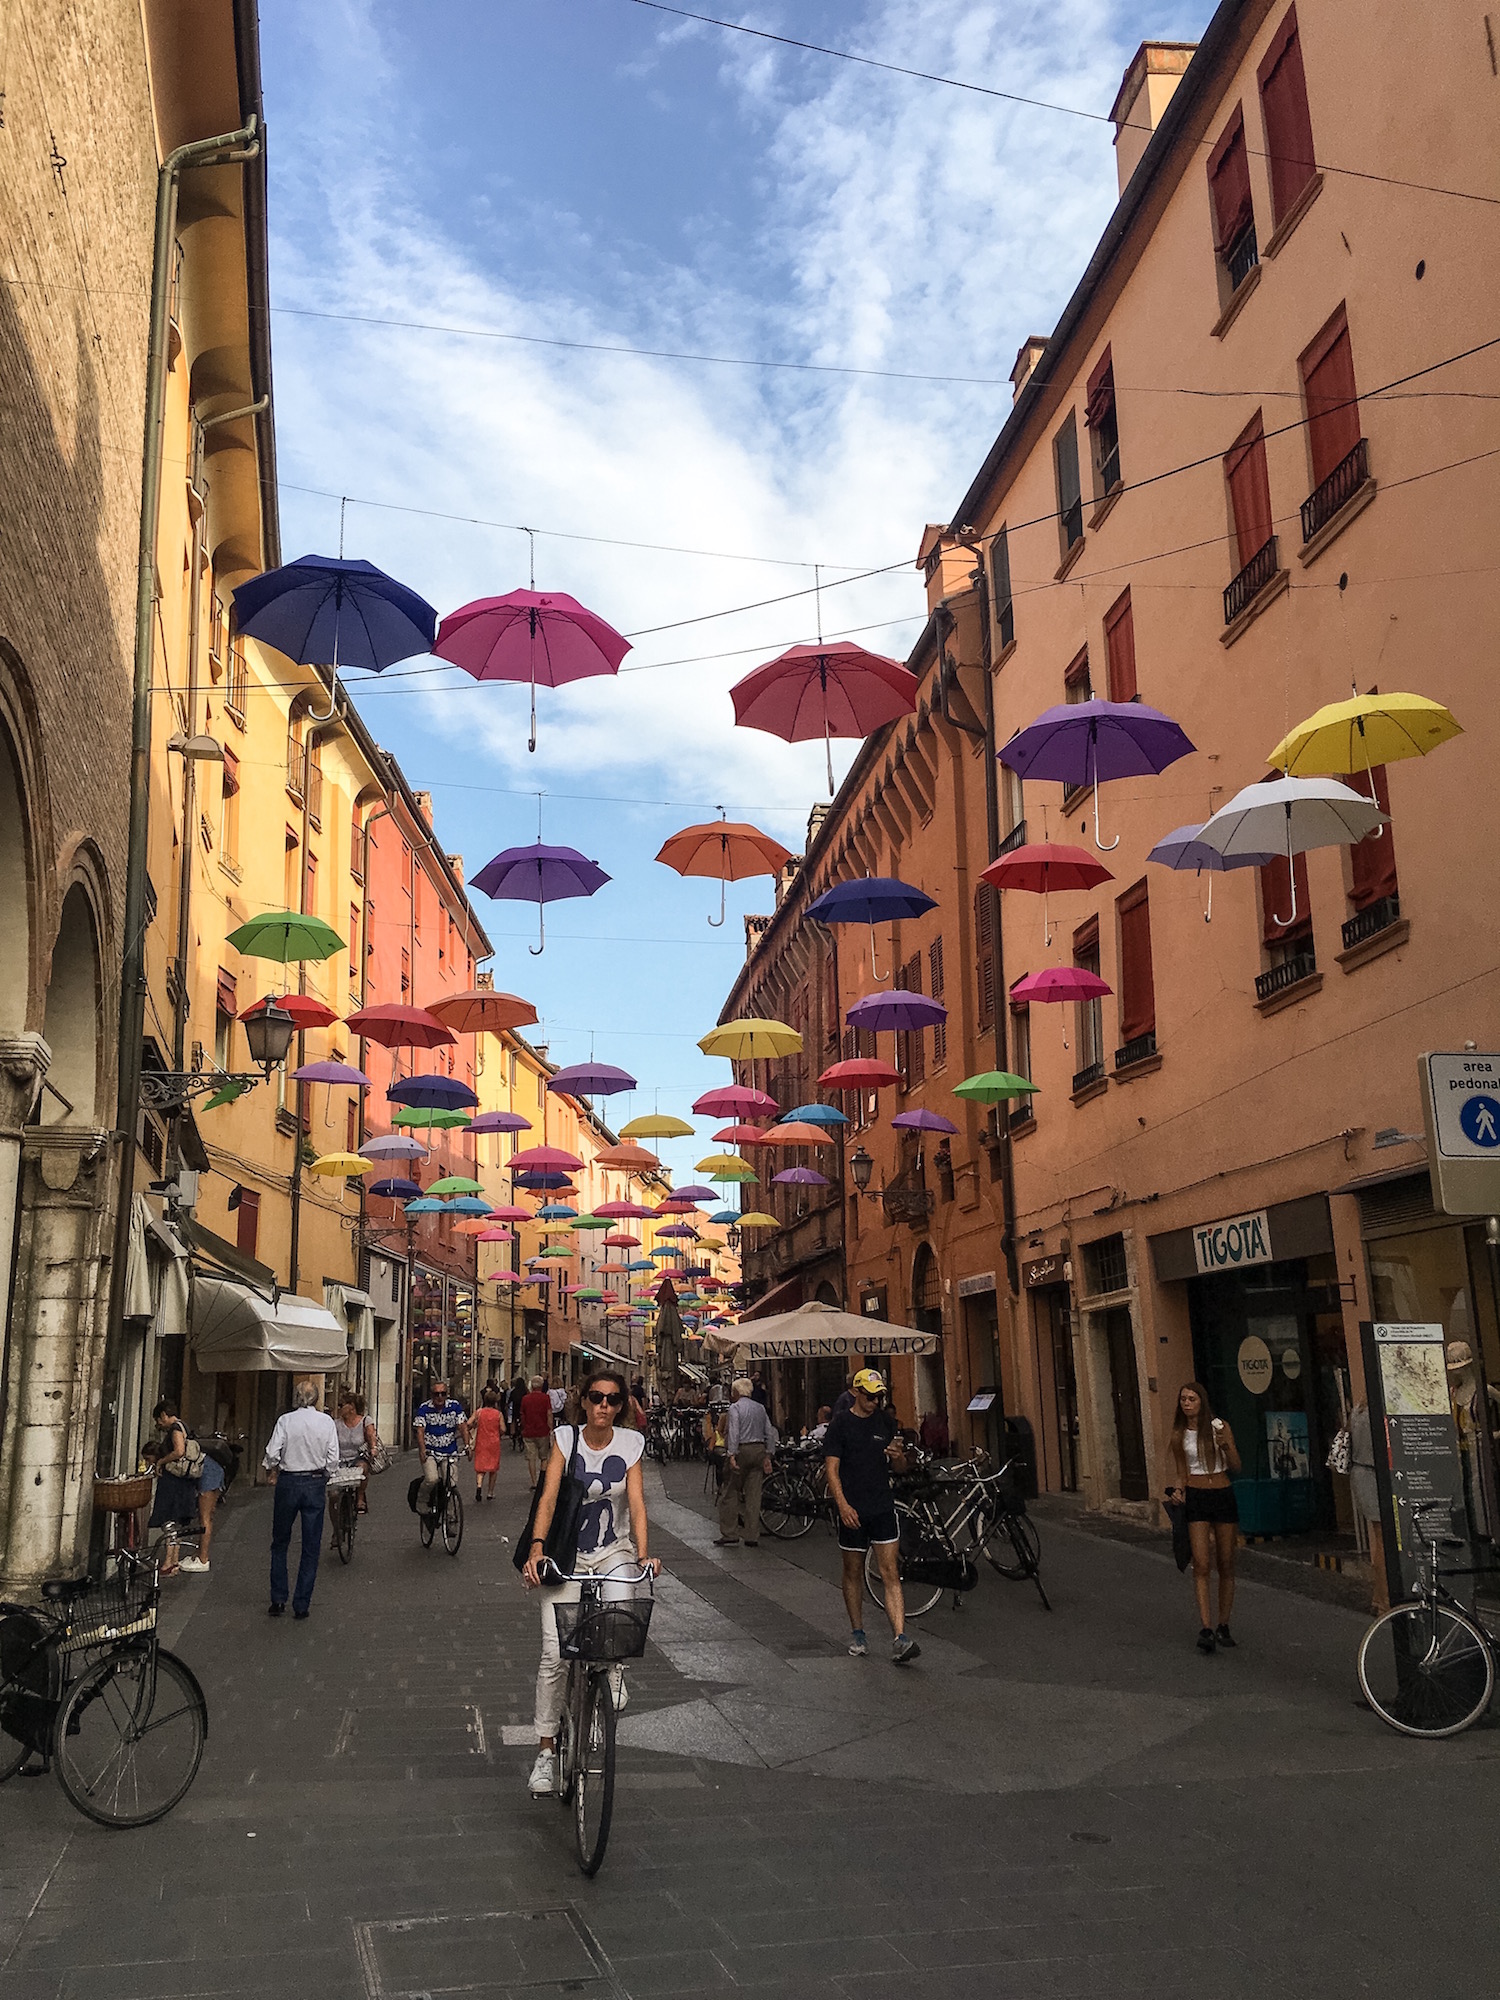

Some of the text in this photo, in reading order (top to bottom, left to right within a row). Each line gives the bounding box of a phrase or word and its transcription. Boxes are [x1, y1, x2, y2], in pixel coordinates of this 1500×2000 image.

[1463, 1062, 1492, 1072] area
[750, 1336, 926, 1359] RIVARENO GELATO
